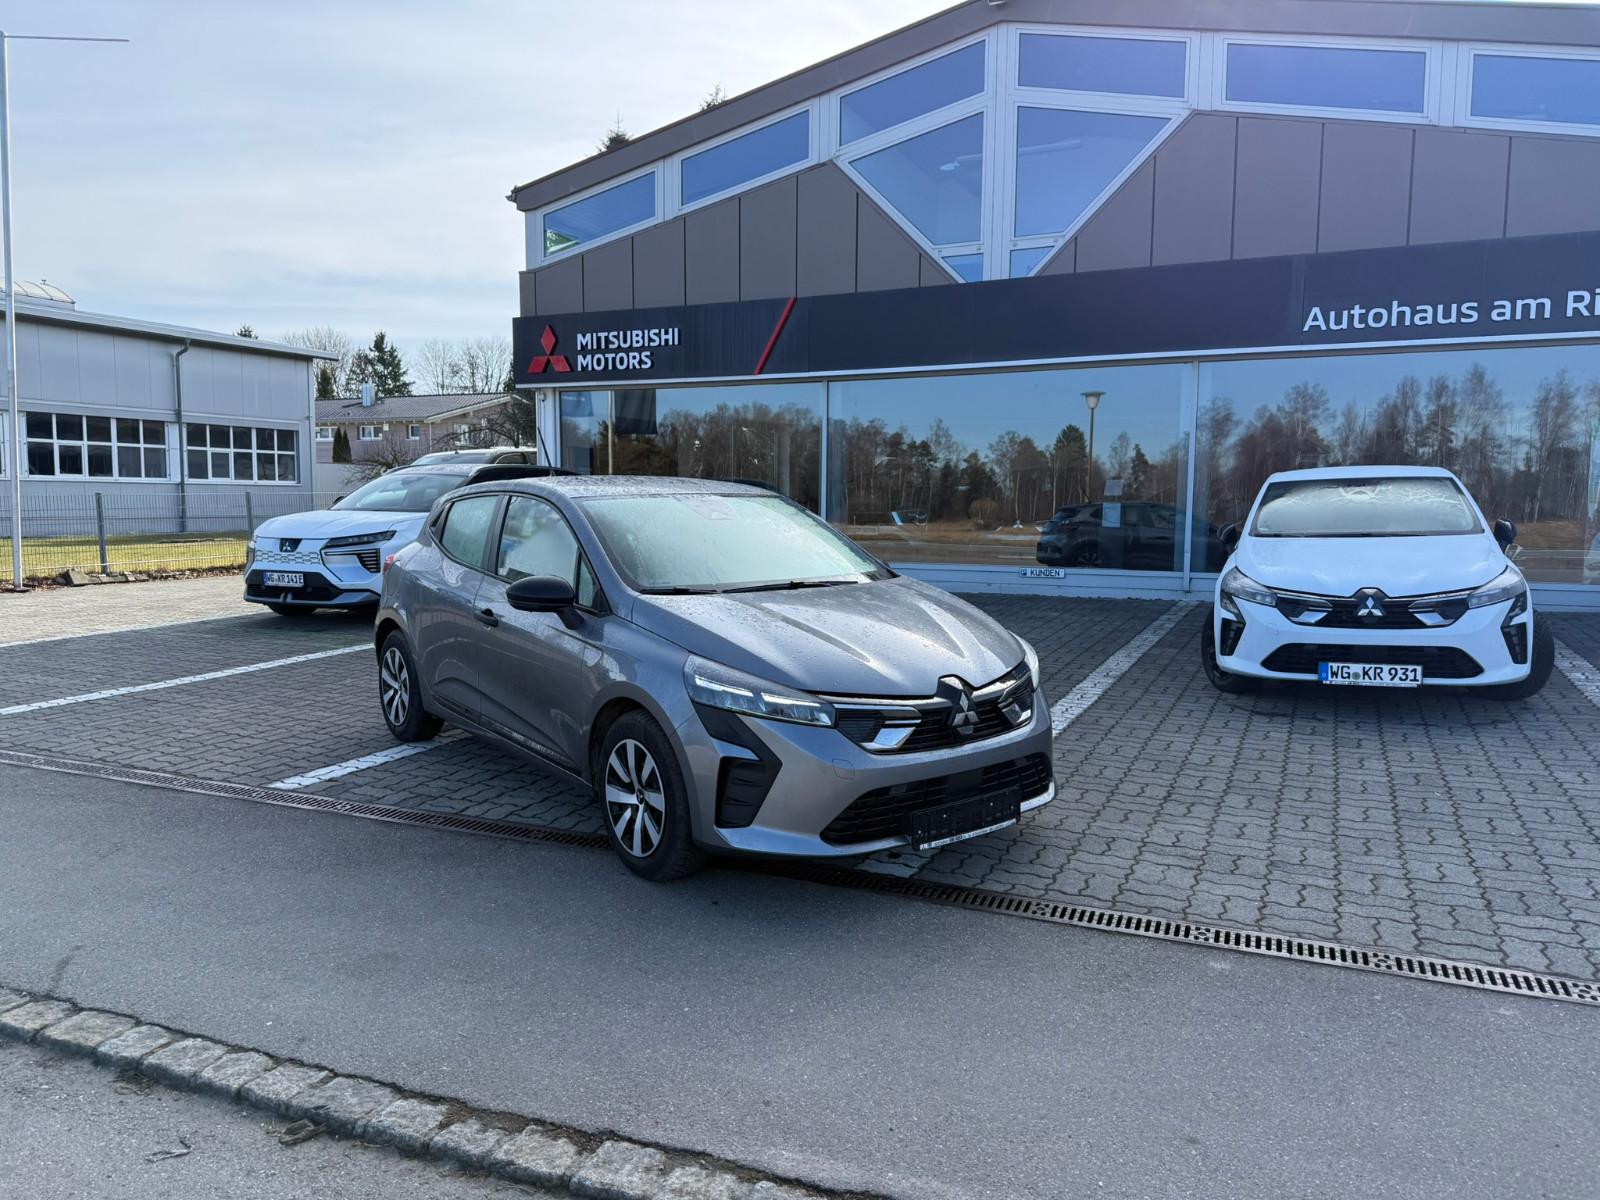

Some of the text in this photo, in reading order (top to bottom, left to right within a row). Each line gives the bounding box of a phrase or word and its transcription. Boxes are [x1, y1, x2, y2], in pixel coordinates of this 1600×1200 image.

[1302, 300, 1479, 331] Autohaus
[1490, 296, 1552, 322] am
[576, 328, 679, 350] MITSUBISHI
[577, 351, 651, 371] MOTORS
[1030, 568, 1060, 577] KUNDEN
[1329, 665, 1351, 680] WG
[1362, 666, 1384, 681] KR
[1388, 667, 1419, 683] 931
